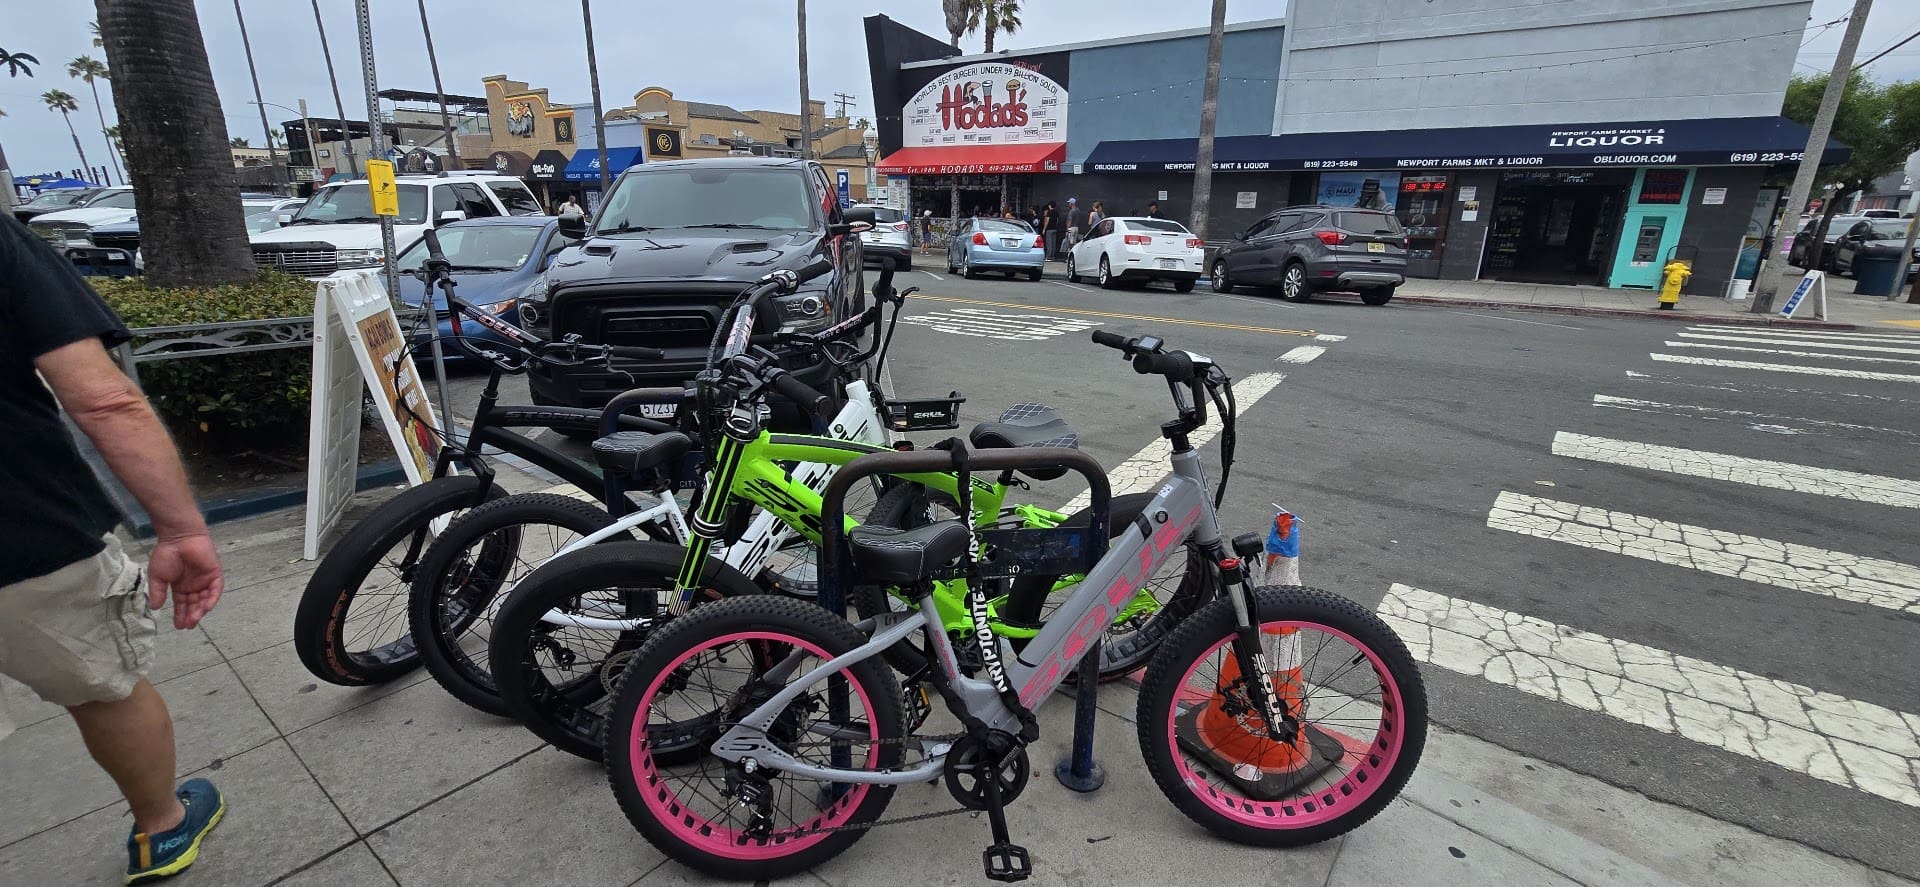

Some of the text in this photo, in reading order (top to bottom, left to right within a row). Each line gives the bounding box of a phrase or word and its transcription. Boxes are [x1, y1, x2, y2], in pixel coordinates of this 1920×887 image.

[938, 74, 952, 87] BEST
[953, 67, 978, 81] BURGER!
[980, 66, 1003, 75] UNDER
[1004, 67, 1013, 76] 99
[1013, 69, 1040, 84] BILLION
[936, 79, 1028, 131] Hodad's
[1549, 135, 1665, 147] LIQUOR
[1396, 157, 1544, 167] NEWPORT FARMS MKT & LIQUOR
[1593, 154, 1677, 164] OBLIQUOR.COM
[1730, 152, 1806, 163] (619) 223-55
[940, 165, 984, 174] HODAD'S
[1220, 162, 1236, 170] MKT
[1303, 160, 1358, 169] (619) 223-5549
[838, 174, 847, 188] P
[972, 591, 1009, 693] KRYPTONITE
[1254, 653, 1283, 734] SOUL
